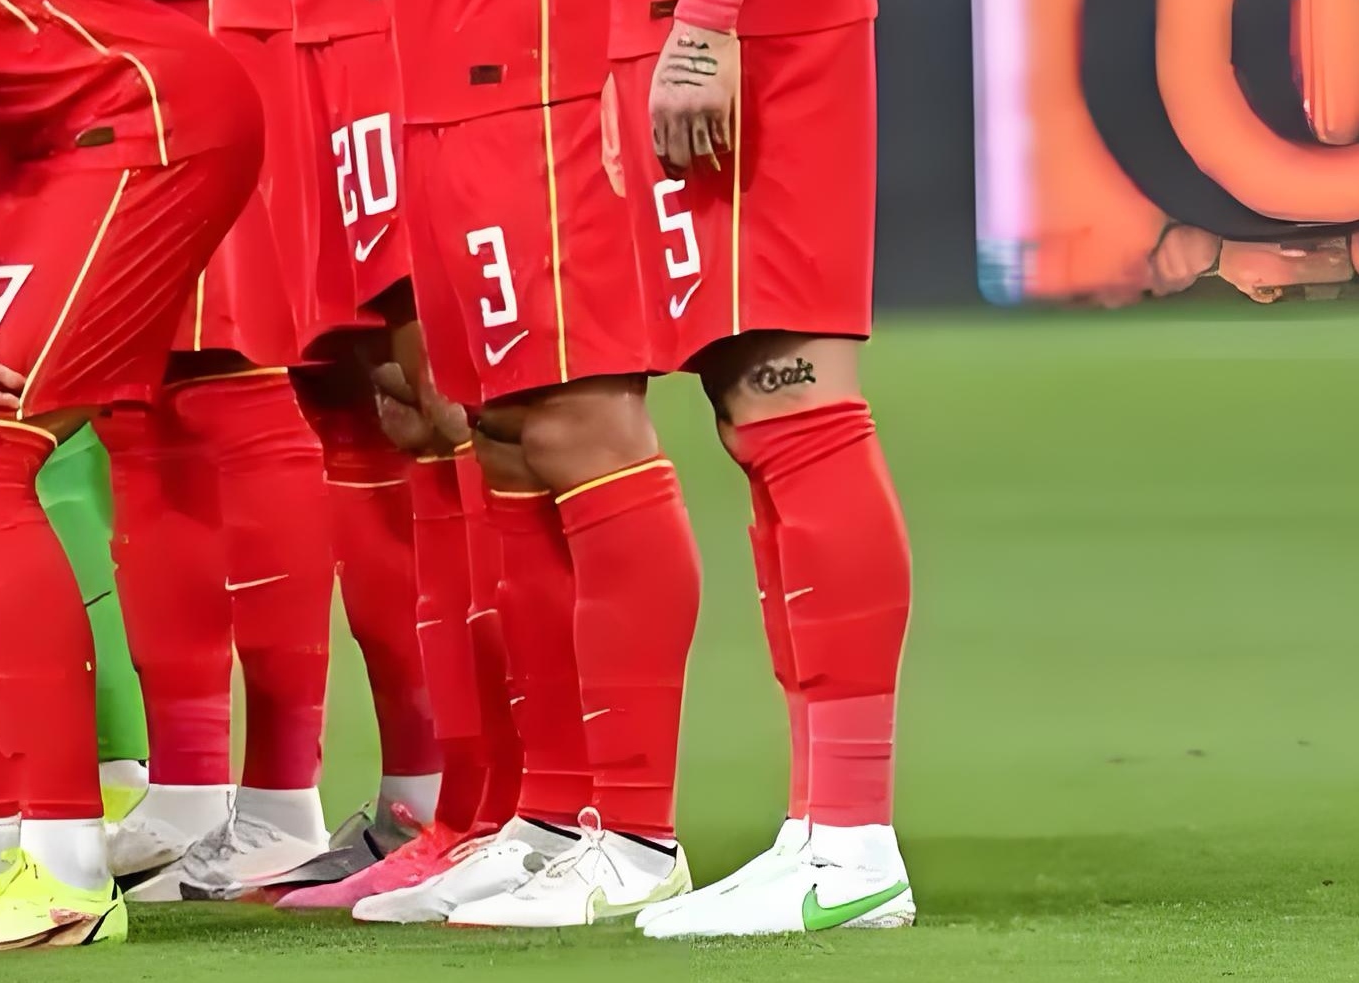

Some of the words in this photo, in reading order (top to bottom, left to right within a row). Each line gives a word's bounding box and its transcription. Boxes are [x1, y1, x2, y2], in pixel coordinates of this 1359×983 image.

[331, 111, 398, 228] 20
[465, 225, 518, 328] 3
[653, 178, 701, 279] 5
